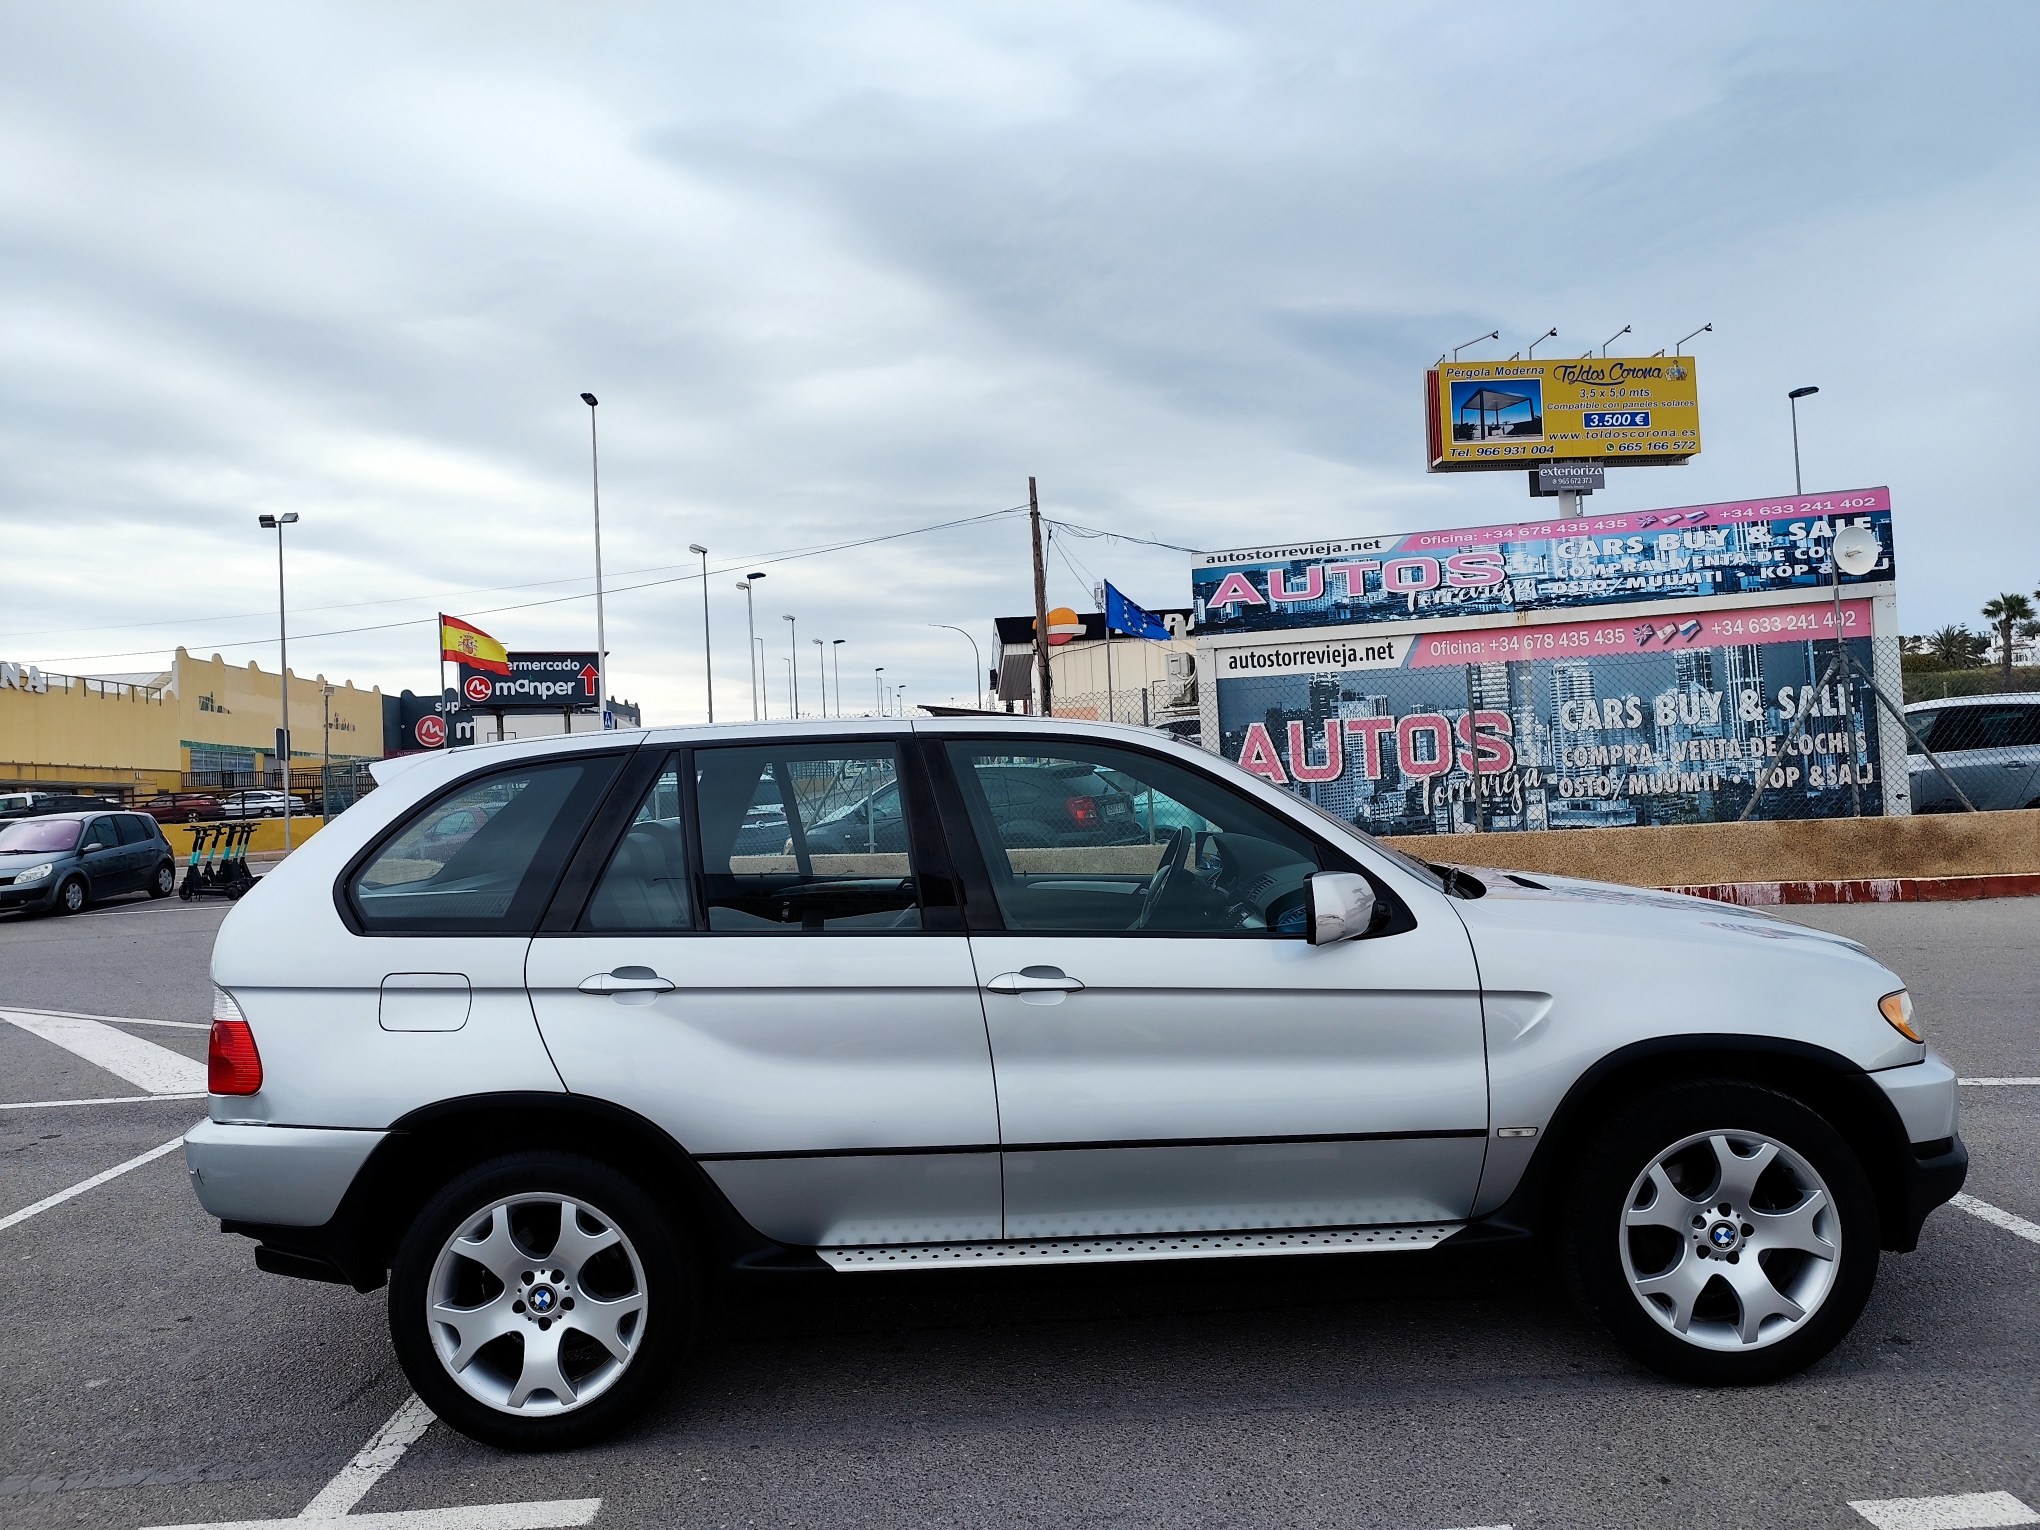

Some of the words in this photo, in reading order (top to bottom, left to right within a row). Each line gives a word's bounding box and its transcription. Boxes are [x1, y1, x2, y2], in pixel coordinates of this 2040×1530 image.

[1446, 367, 1490, 379] Pérgola
[1495, 366, 1545, 376] Moderna
[1553, 364, 1605, 385] Toldos
[1609, 362, 1663, 381] Corona
[1580, 388, 1596, 399] 3,5
[1600, 390, 1606, 398] x
[1609, 387, 1626, 399] 5,0
[1629, 388, 1653, 398] mts.
[1547, 401, 1600, 411] Compatible
[1622, 400, 1658, 409] paneles
[1661, 399, 1695, 408] solares
[1589, 413, 1631, 427] 3.500
[1634, 413, 1645, 426] €
[1549, 429, 1696, 441] www.toldoscorona.es
[1618, 442, 1643, 452] 665
[1647, 441, 1669, 451] 166
[1672, 440, 1696, 451] 572
[1450, 448, 1472, 457] Tel.
[1476, 447, 1500, 457] 966
[1503, 446, 1527, 456] 931
[1531, 445, 1555, 455] 004
[1540, 465, 1603, 477] exterioriza
[1420, 533, 1478, 546] Oficina:
[1482, 528, 1514, 540] +34
[1519, 526, 1551, 536] 678
[1556, 522, 1589, 533] 435
[1594, 519, 1628, 530] 435
[1720, 507, 1754, 519] +34
[1759, 504, 1795, 516] 633
[1800, 500, 1835, 512] 241
[1839, 497, 1876, 508] 402
[1206, 539, 1382, 564] autostorrevieja.net
[1557, 536, 1644, 559] CARS
[1658, 528, 1731, 550] BUY
[1747, 525, 1773, 544] &
[1557, 559, 1654, 578] COMPRA
[1677, 552, 1749, 569] VENTA
[1757, 549, 1785, 563] DE
[1206, 552, 1506, 609] AUTOS
[1430, 639, 1485, 656] Oficina:
[1489, 636, 1520, 652] +34
[1523, 633, 1554, 650] 678
[1558, 631, 1590, 648] 435
[1594, 628, 1626, 645] 435
[1711, 619, 1744, 636] +34
[1748, 616, 1782, 634] 633
[1786, 613, 1818, 631] 241
[507, 659, 580, 671] ermercado
[1228, 641, 1395, 670] autostorrevieja.net
[495, 679, 576, 700] manper
[1560, 696, 1643, 732] CARS
[1655, 691, 1723, 727] BUY
[1739, 688, 1765, 721] &
[1236, 710, 1515, 784] AUTOS
[1561, 743, 1654, 768] COMPRA
[1672, 737, 1743, 762] VENTA
[1750, 736, 1778, 758] DE
